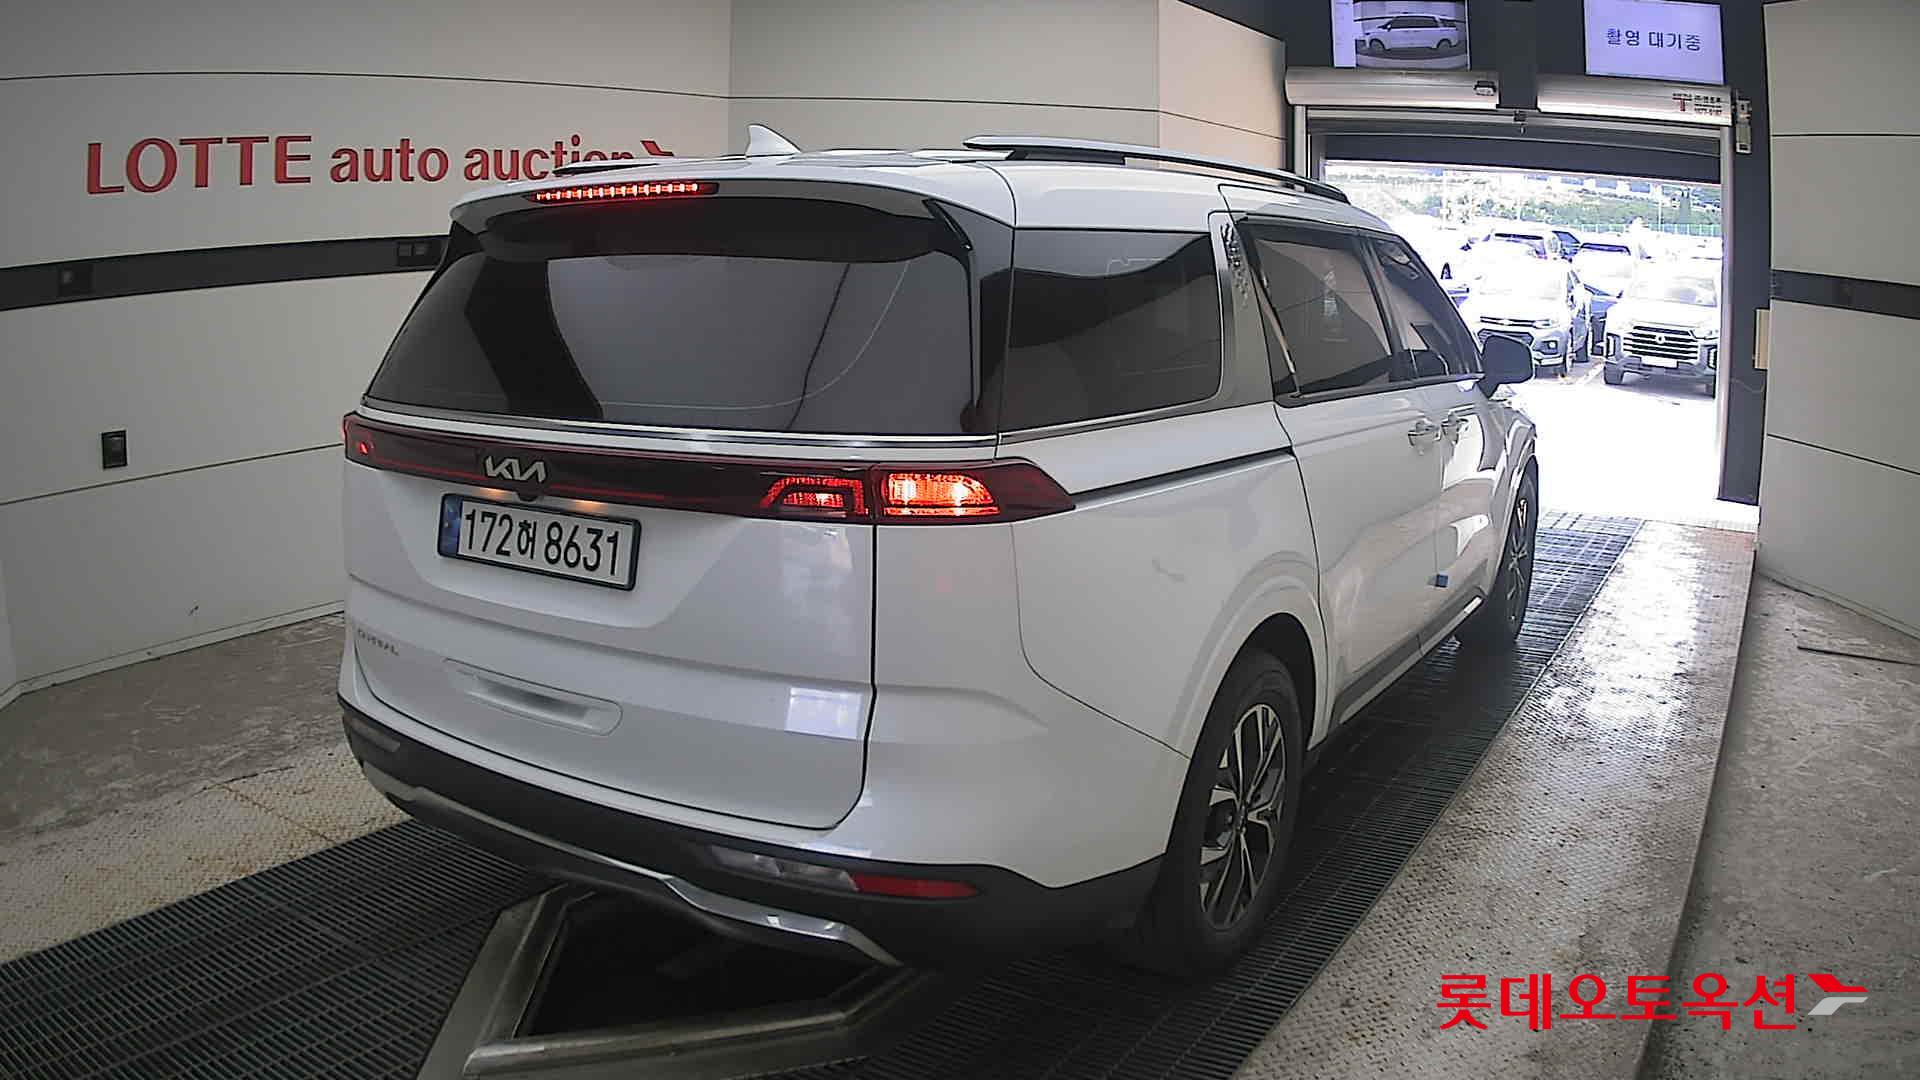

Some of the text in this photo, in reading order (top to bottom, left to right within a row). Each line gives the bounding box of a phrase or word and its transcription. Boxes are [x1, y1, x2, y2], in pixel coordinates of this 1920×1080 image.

[1647, 31, 1702, 52] 대기중
[87, 135, 312, 195] LOTTE
[329, 138, 449, 183] auto
[485, 455, 547, 483] KIA
[465, 508, 620, 576] 172허 8631
